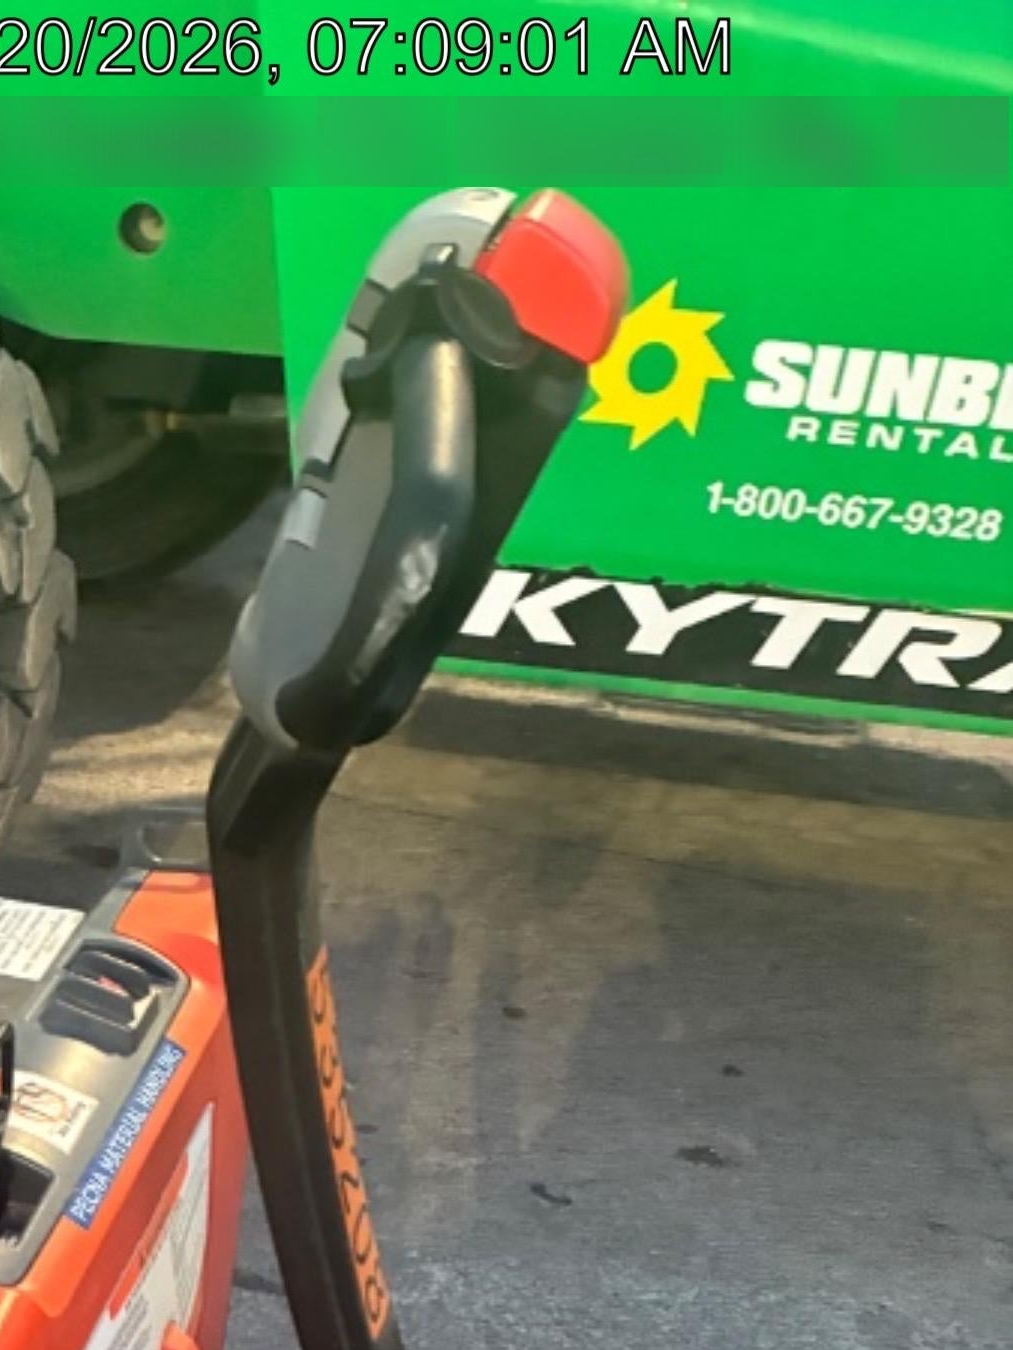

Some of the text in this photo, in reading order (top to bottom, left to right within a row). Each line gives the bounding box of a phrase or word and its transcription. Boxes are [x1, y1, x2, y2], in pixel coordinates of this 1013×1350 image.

[786, 416, 1013, 463] RENTAL
[707, 480, 1003, 541] 1-800-667-9328
[98, 1106, 148, 1175] MATERIAL
